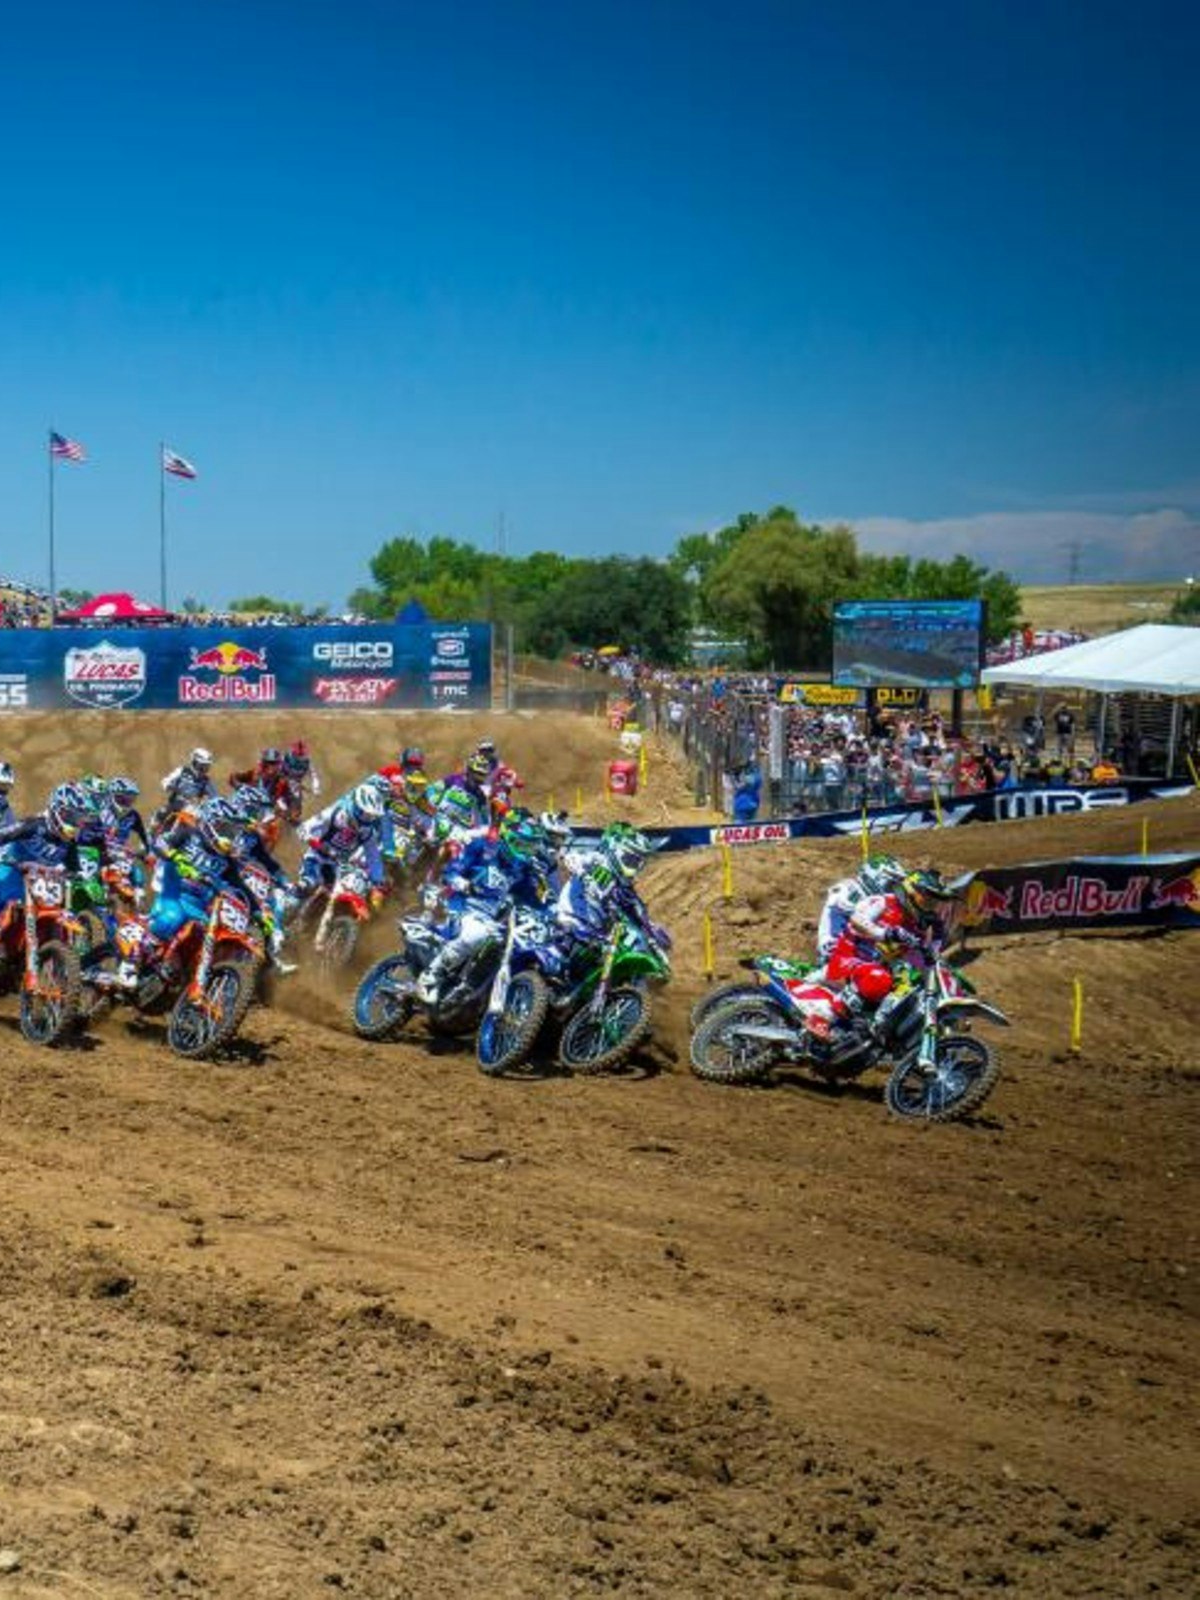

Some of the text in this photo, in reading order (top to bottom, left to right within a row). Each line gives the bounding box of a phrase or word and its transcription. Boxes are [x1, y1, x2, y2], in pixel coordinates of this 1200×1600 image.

[313, 642, 393, 659] GEICO
[75, 663, 139, 678] LUCAS
[179, 674, 276, 702] Red Bull
[763, 824, 788, 839] OIL
[1020, 875, 1150, 919] Red Bull
